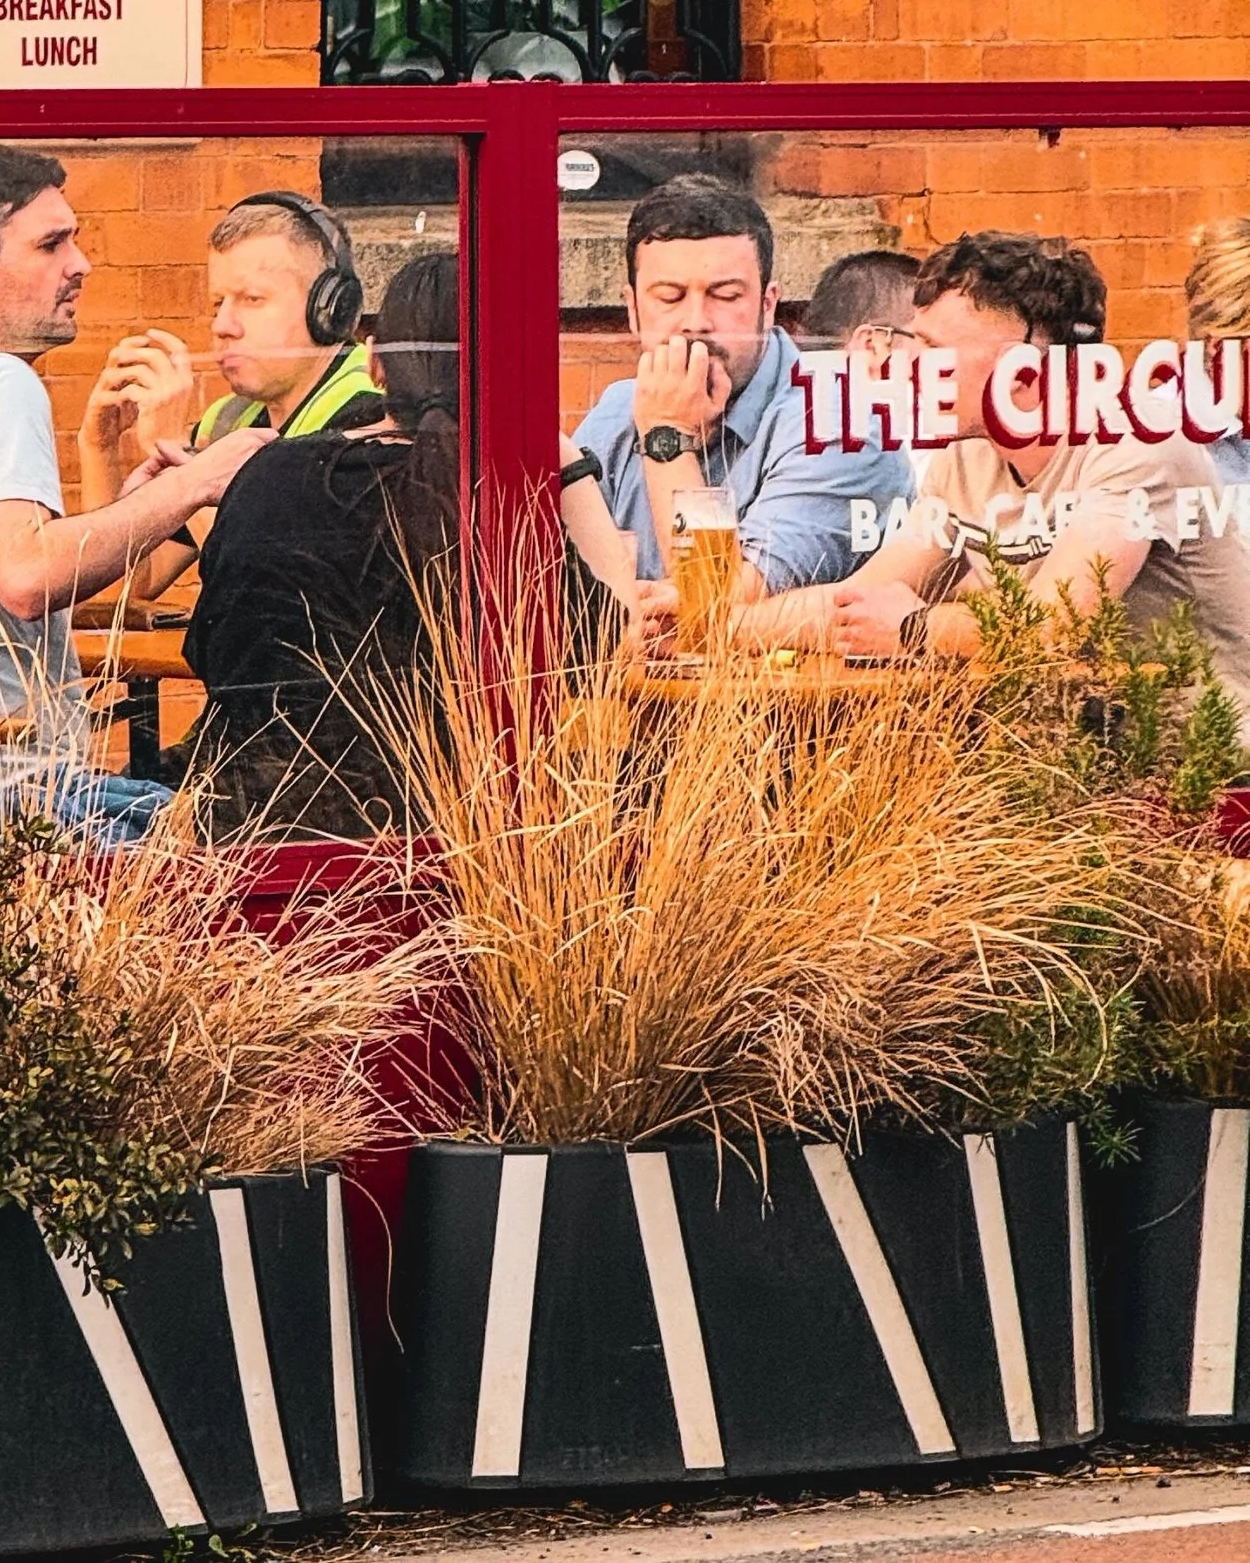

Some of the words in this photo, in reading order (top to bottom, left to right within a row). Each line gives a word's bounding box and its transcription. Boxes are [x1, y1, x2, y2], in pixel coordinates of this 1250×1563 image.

[21, 36, 98, 67] LUNCH
[792, 347, 959, 455] THE
[982, 339, 1250, 450] CIRCU
